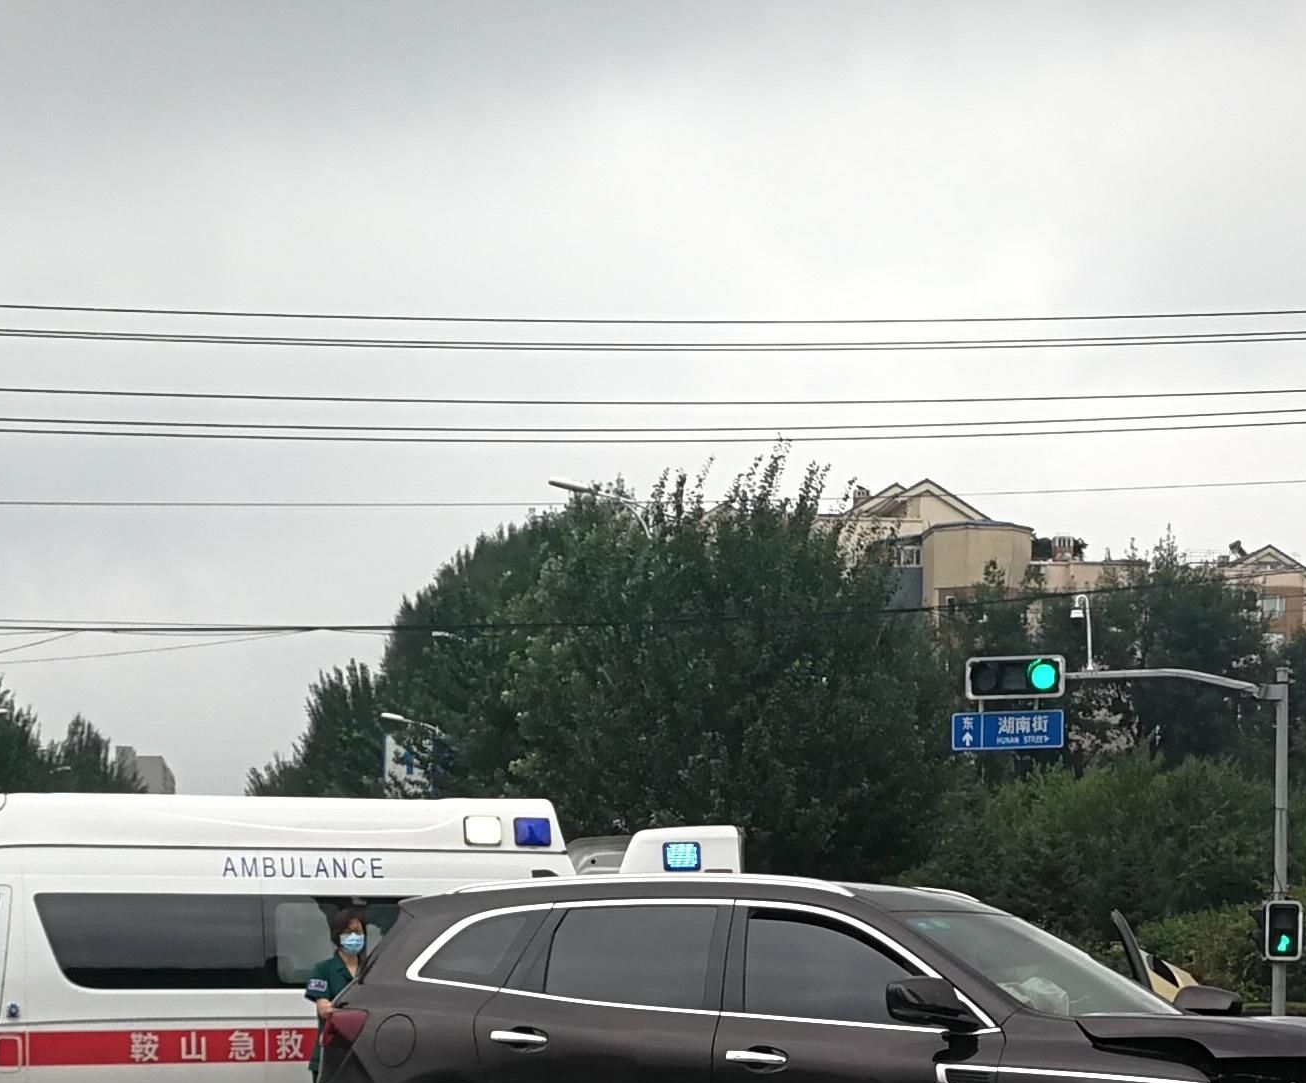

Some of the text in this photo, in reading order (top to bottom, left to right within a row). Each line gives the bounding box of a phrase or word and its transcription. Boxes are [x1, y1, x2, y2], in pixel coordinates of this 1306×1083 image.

[962, 716, 974, 730] 东
[997, 715, 1049, 735] 湖南街
[222, 856, 386, 879] AMBULANCE
[130, 1030, 305, 1062] 鞍山急救
